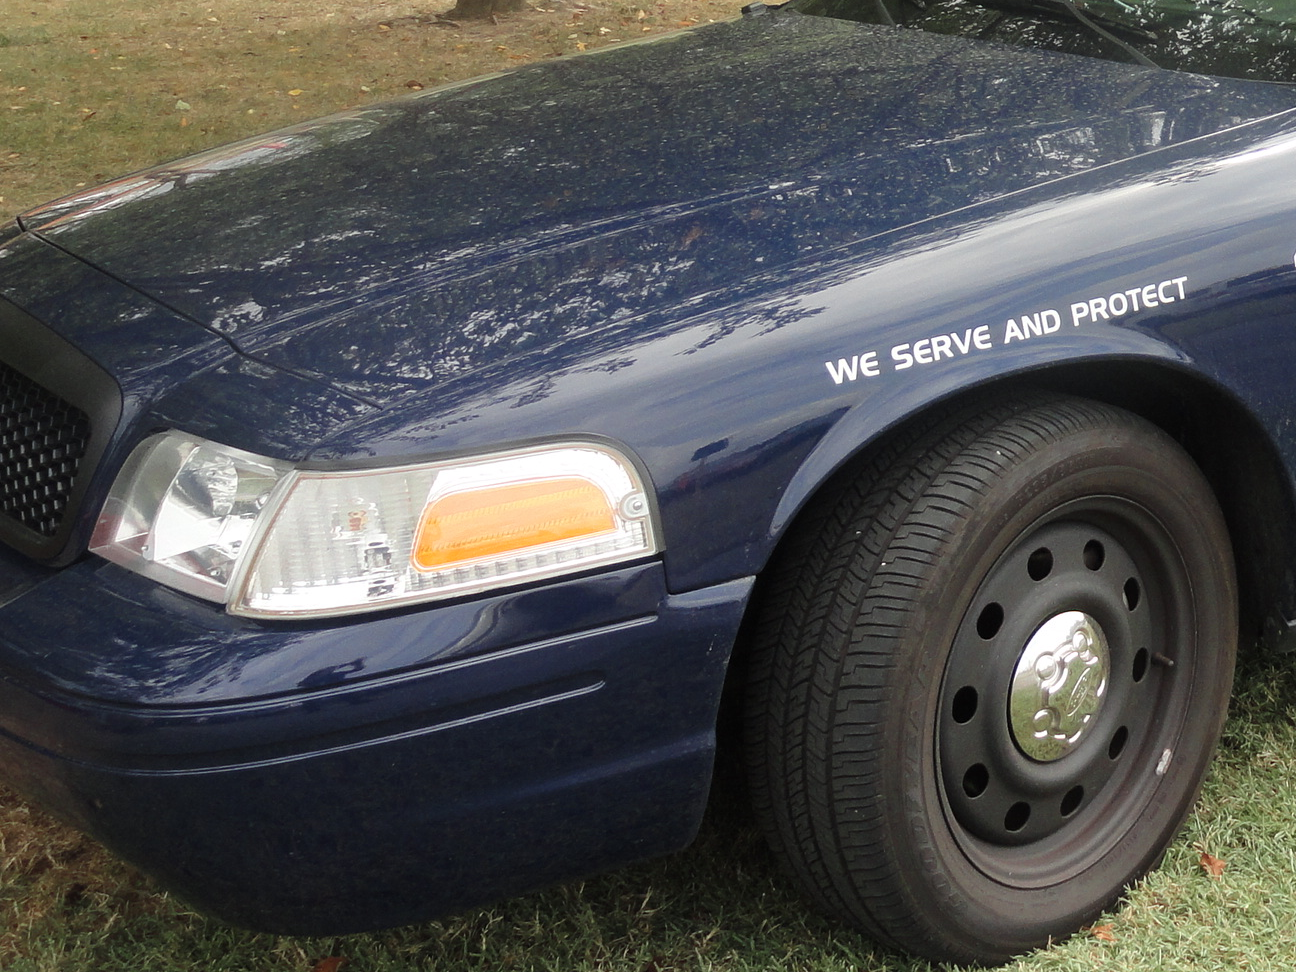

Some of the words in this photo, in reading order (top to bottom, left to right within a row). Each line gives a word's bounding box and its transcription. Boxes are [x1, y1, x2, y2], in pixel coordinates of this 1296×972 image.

[825, 352, 881, 385] WE
[891, 324, 993, 371] SERVE
[1003, 309, 1062, 345] AND
[1070, 275, 1189, 327] PROTECT
